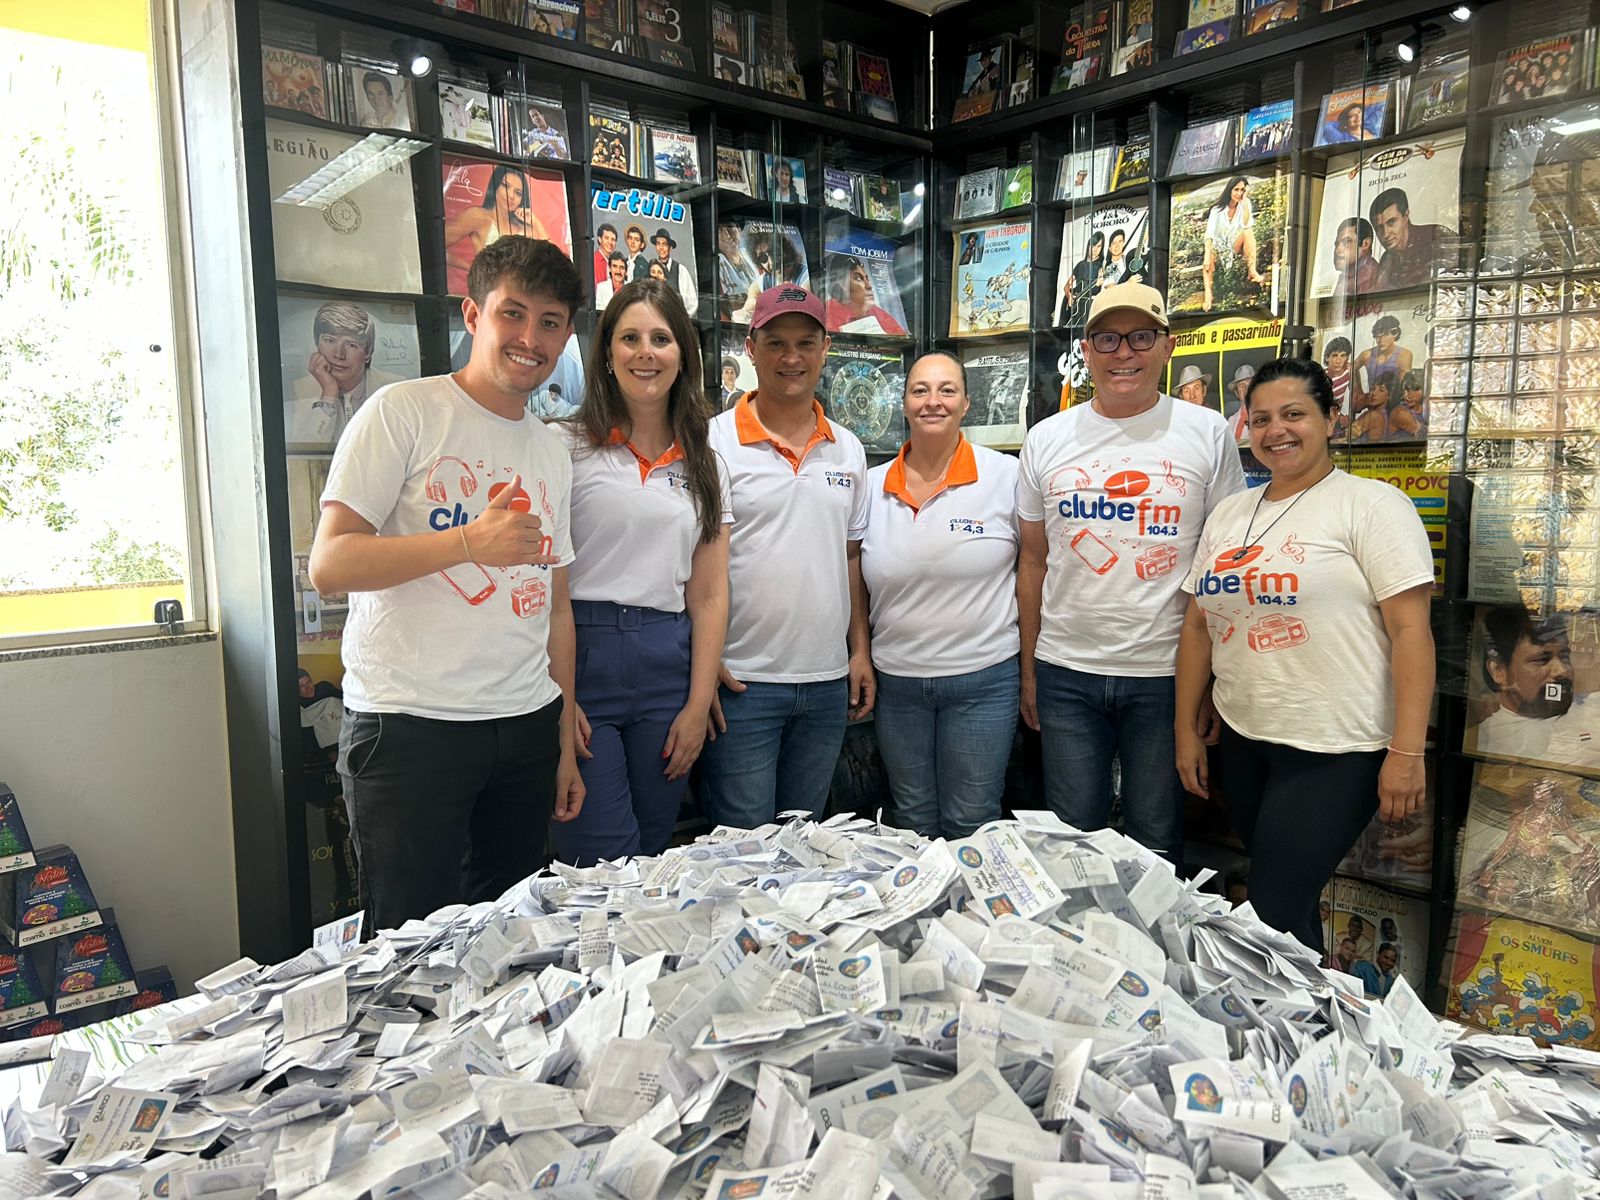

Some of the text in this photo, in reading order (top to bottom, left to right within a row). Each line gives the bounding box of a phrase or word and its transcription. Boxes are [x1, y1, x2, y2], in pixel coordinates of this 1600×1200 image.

[1065, 23, 1108, 43] ORQUESTRA
[1065, 39, 1101, 59] da TERRA
[267, 137, 329, 160] EGIÃO
[1376, 156, 1404, 168] TERRA
[851, 246, 888, 259] TOM JOBIM
[1176, 323, 1282, 347] anário e passarinho
[1405, 475, 1449, 490] POVO
[1547, 686, 1558, 697] D
[312, 845, 334, 861] SOY
[1336, 902, 1378, 917] MEU RECADO
[22, 931, 45, 943] coamo
[1537, 937, 1552, 946] VEM
[1500, 935, 1579, 965] OS SMURFS
[59, 999, 82, 1010] coamo
